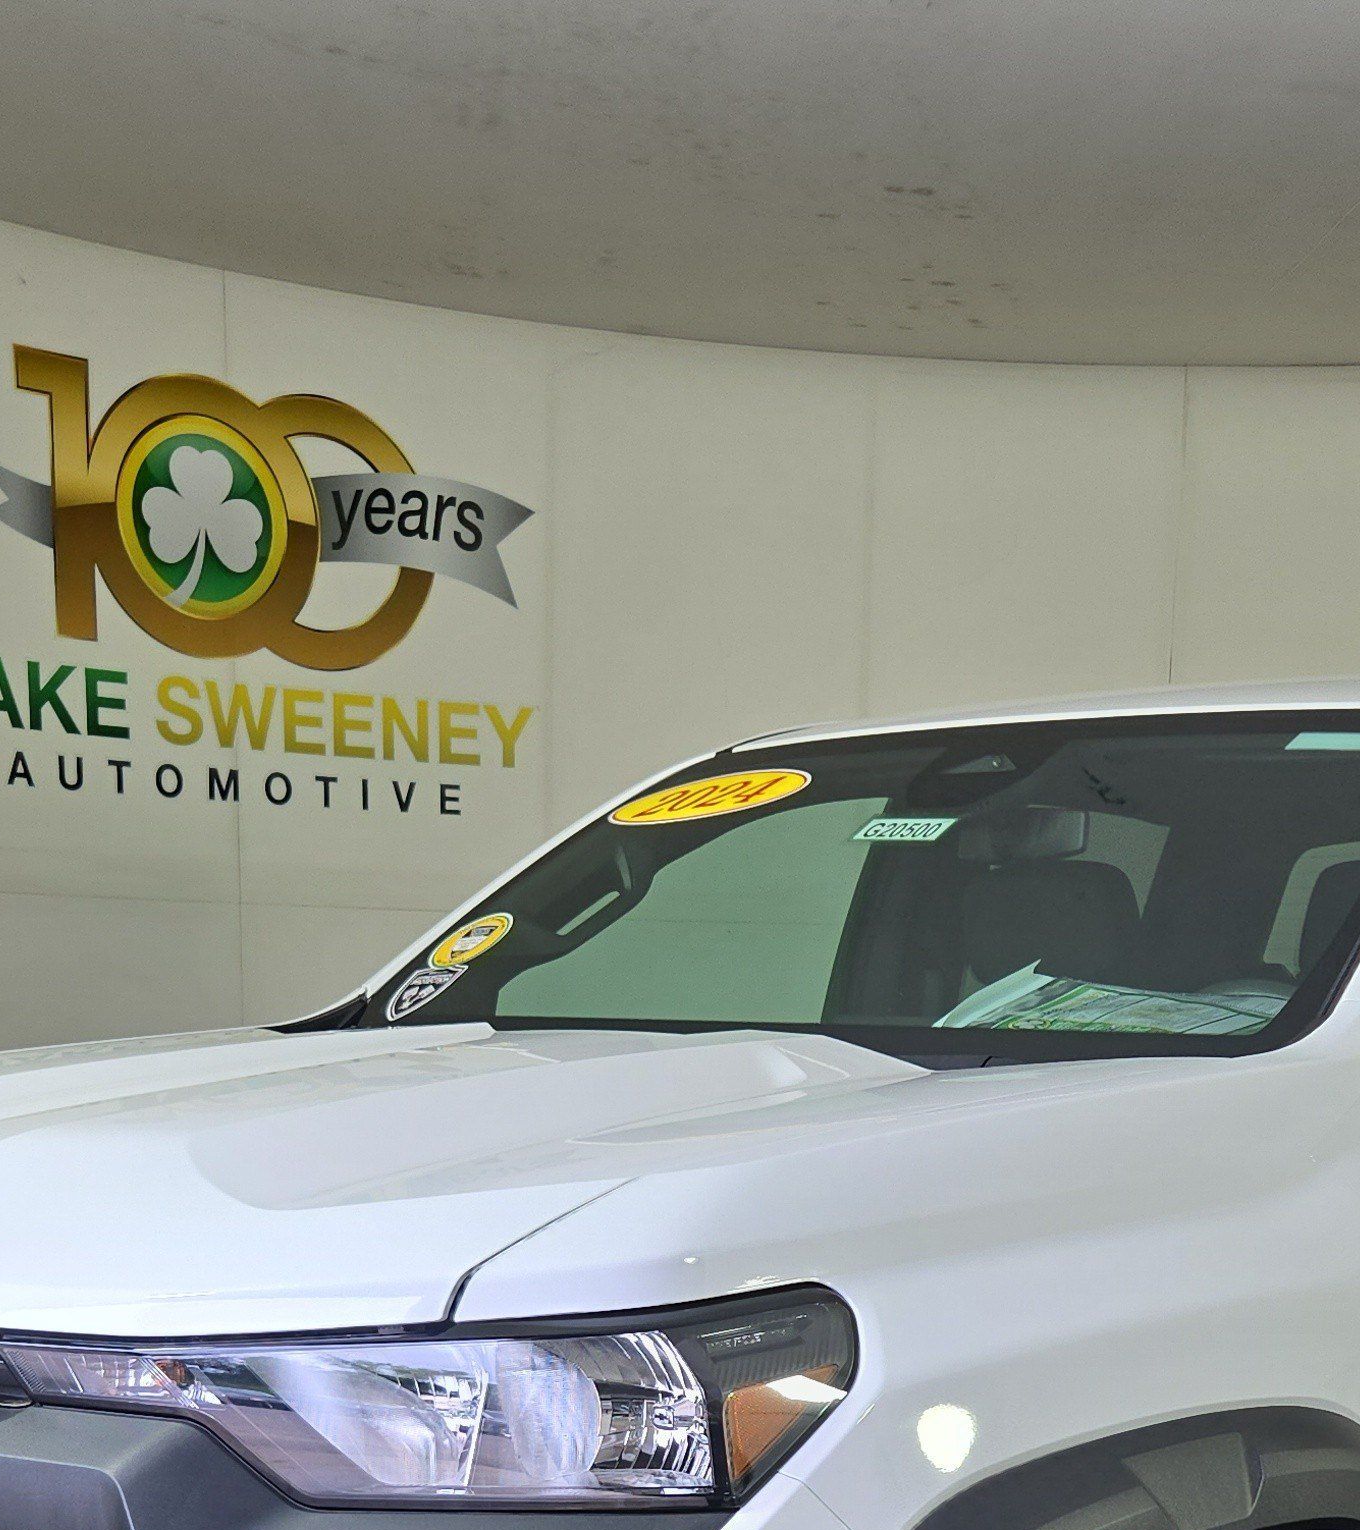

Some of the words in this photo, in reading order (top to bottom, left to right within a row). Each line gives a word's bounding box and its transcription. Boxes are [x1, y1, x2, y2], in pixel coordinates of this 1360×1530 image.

[12, 342, 435, 672] 100
[330, 486, 485, 552] years
[154, 674, 534, 769] SWEENEY
[7, 750, 462, 816] AUTOMOTIVE
[630, 775, 788, 819] 2024
[862, 820, 943, 839] G20500
